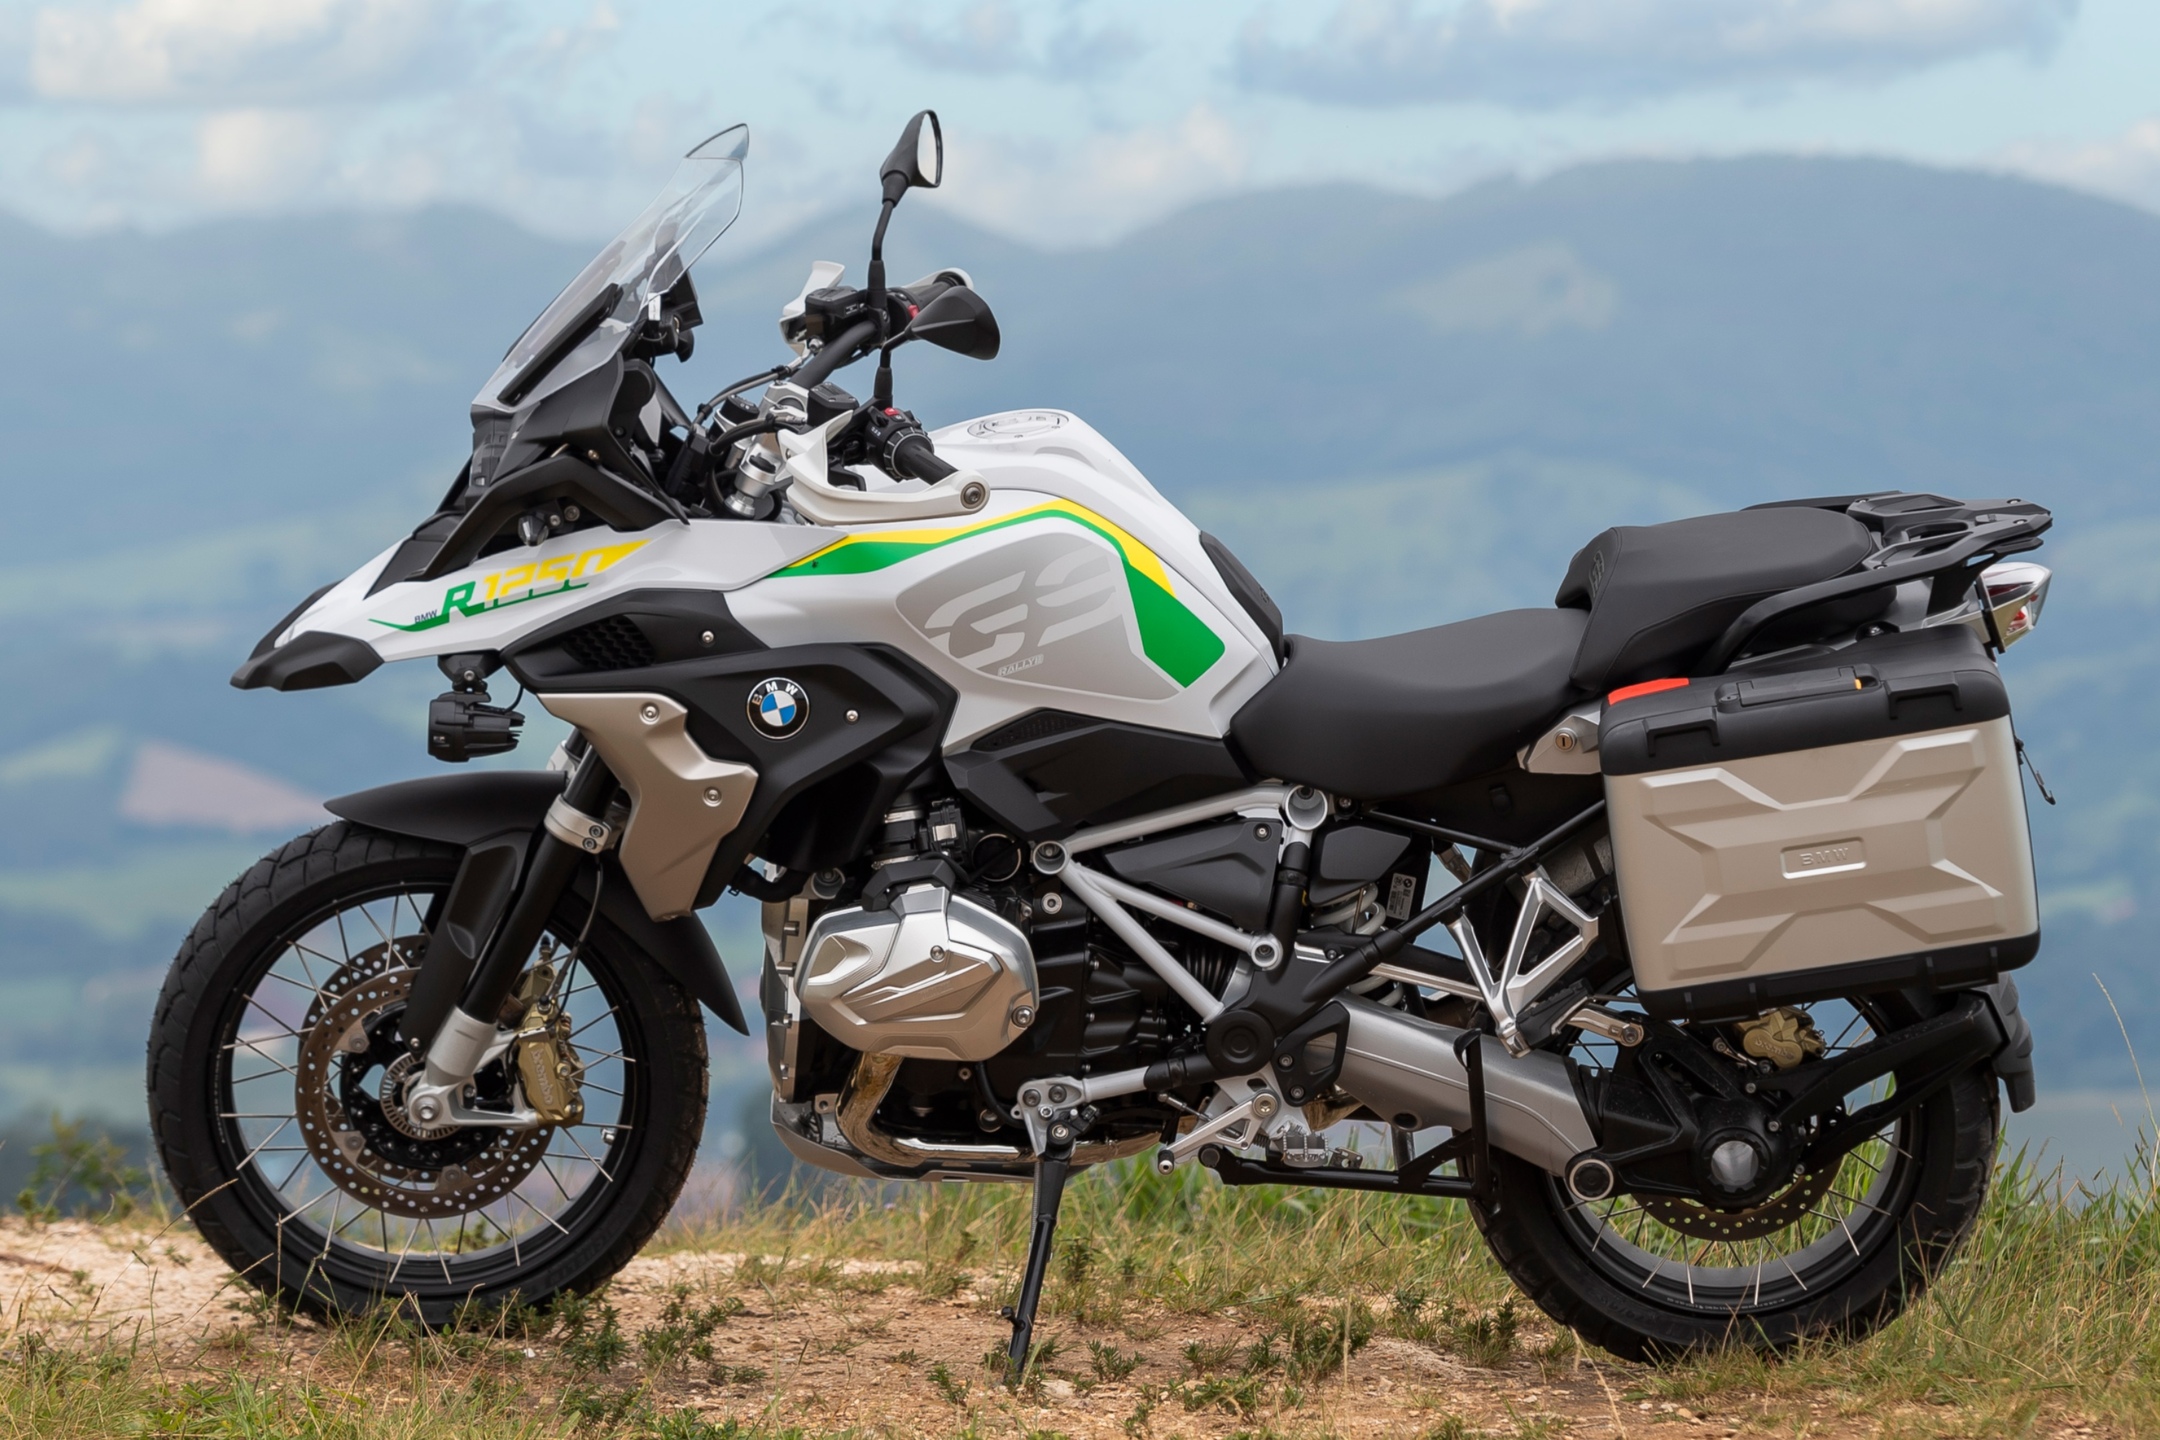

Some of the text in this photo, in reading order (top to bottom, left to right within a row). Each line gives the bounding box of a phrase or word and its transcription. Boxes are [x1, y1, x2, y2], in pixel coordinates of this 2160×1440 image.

[414, 609, 438, 624] BMW
[751, 680, 799, 706] BMW
[1799, 847, 1849, 867] BMW
